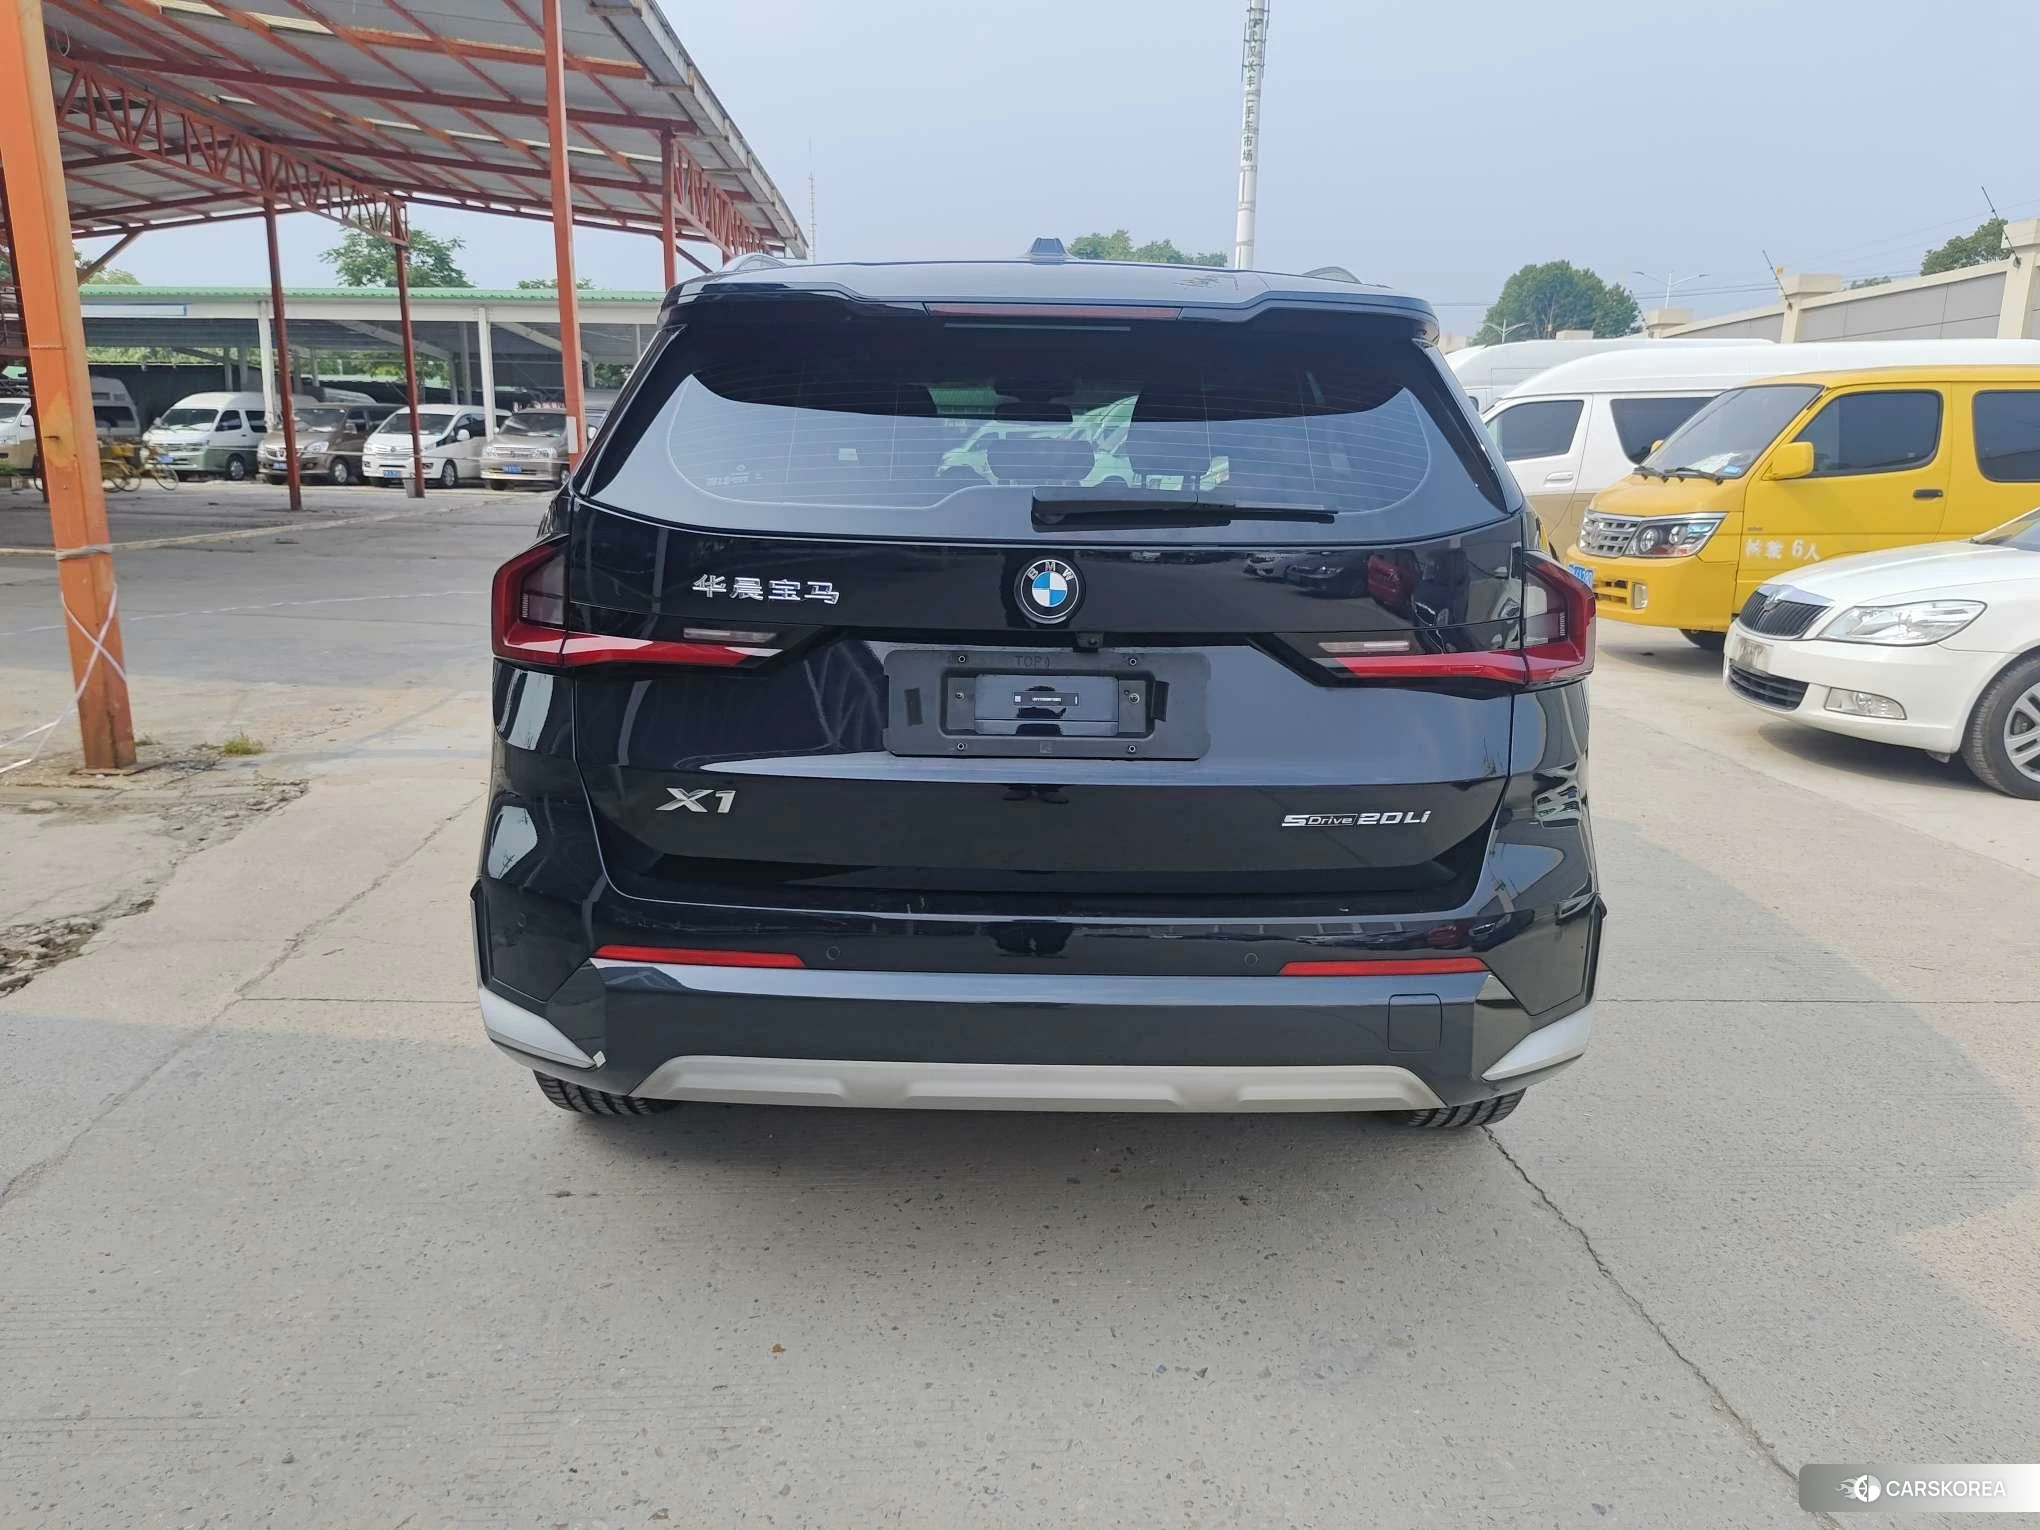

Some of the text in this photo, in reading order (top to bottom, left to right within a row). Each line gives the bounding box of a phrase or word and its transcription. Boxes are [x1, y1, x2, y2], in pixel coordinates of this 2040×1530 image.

[1027, 561, 1075, 581] BMW
[691, 573, 840, 605] 华晨宝马
[655, 787, 736, 813] X1
